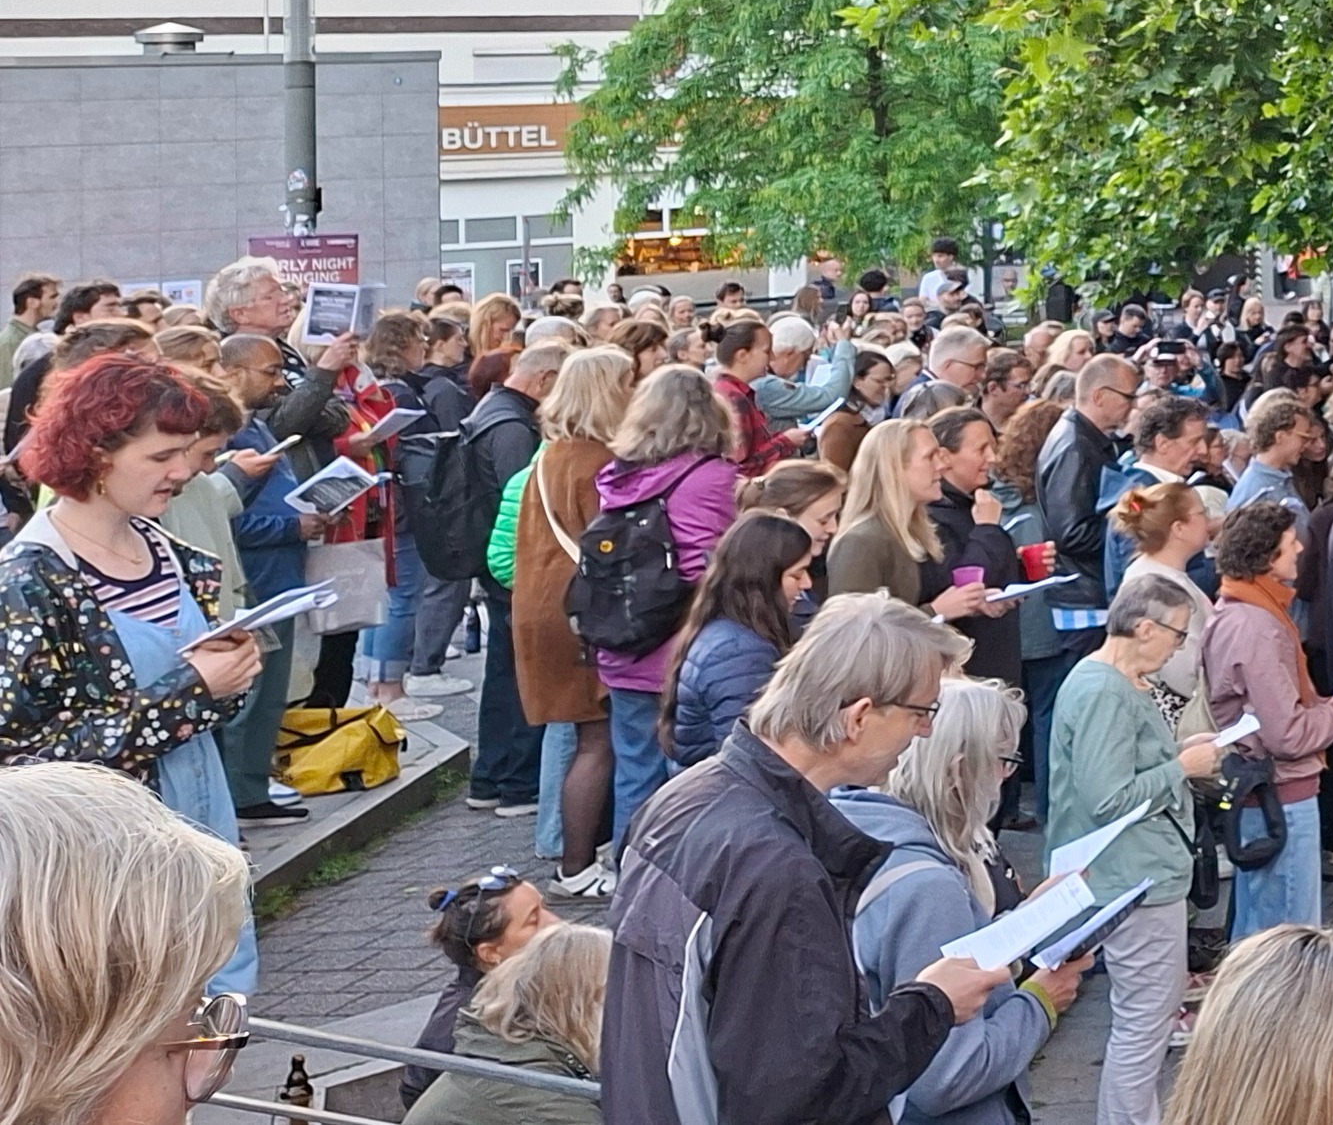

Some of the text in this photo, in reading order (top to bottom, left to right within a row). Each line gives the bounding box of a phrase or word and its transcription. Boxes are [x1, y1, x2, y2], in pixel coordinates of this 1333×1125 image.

[442, 121, 557, 150] BÜTTEL
[278, 257, 355, 273] RLY NIGHT
